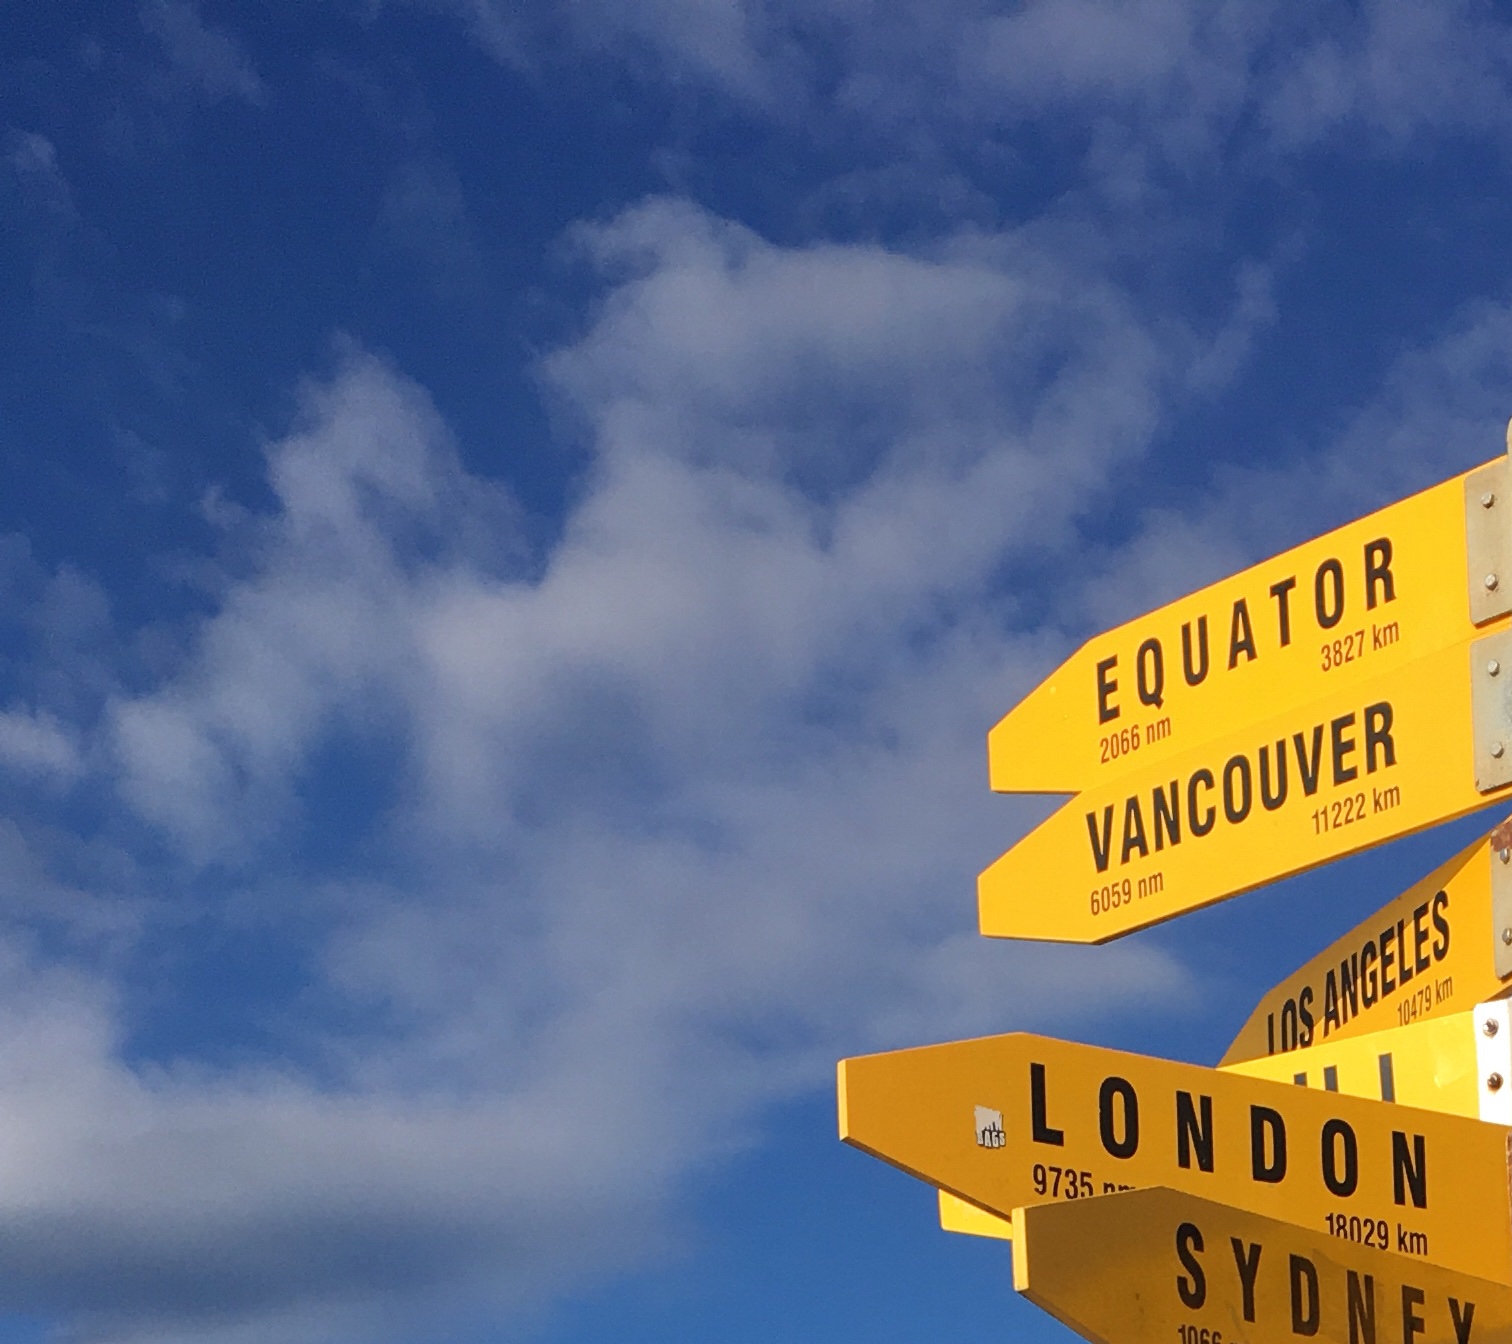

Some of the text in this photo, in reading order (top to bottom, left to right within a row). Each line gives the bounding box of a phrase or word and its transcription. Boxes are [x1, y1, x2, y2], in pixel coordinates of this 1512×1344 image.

[1096, 536, 1398, 726] EQUATOR
[1320, 619, 1401, 673] 3827 km
[1098, 715, 1173, 765] 2066 nm
[1085, 699, 1398, 874] VANCOUVER
[1311, 781, 1401, 836] 11222 km
[1089, 871, 1164, 917] 6059 nm
[1266, 890, 1450, 1056] LOS ANGELES
[1396, 976, 1454, 1028] 10479 km
[1029, 1062, 1428, 1209] LONDON
[1032, 1163, 1094, 1200] 9735
[1324, 1212, 1428, 1256] 18029 km
